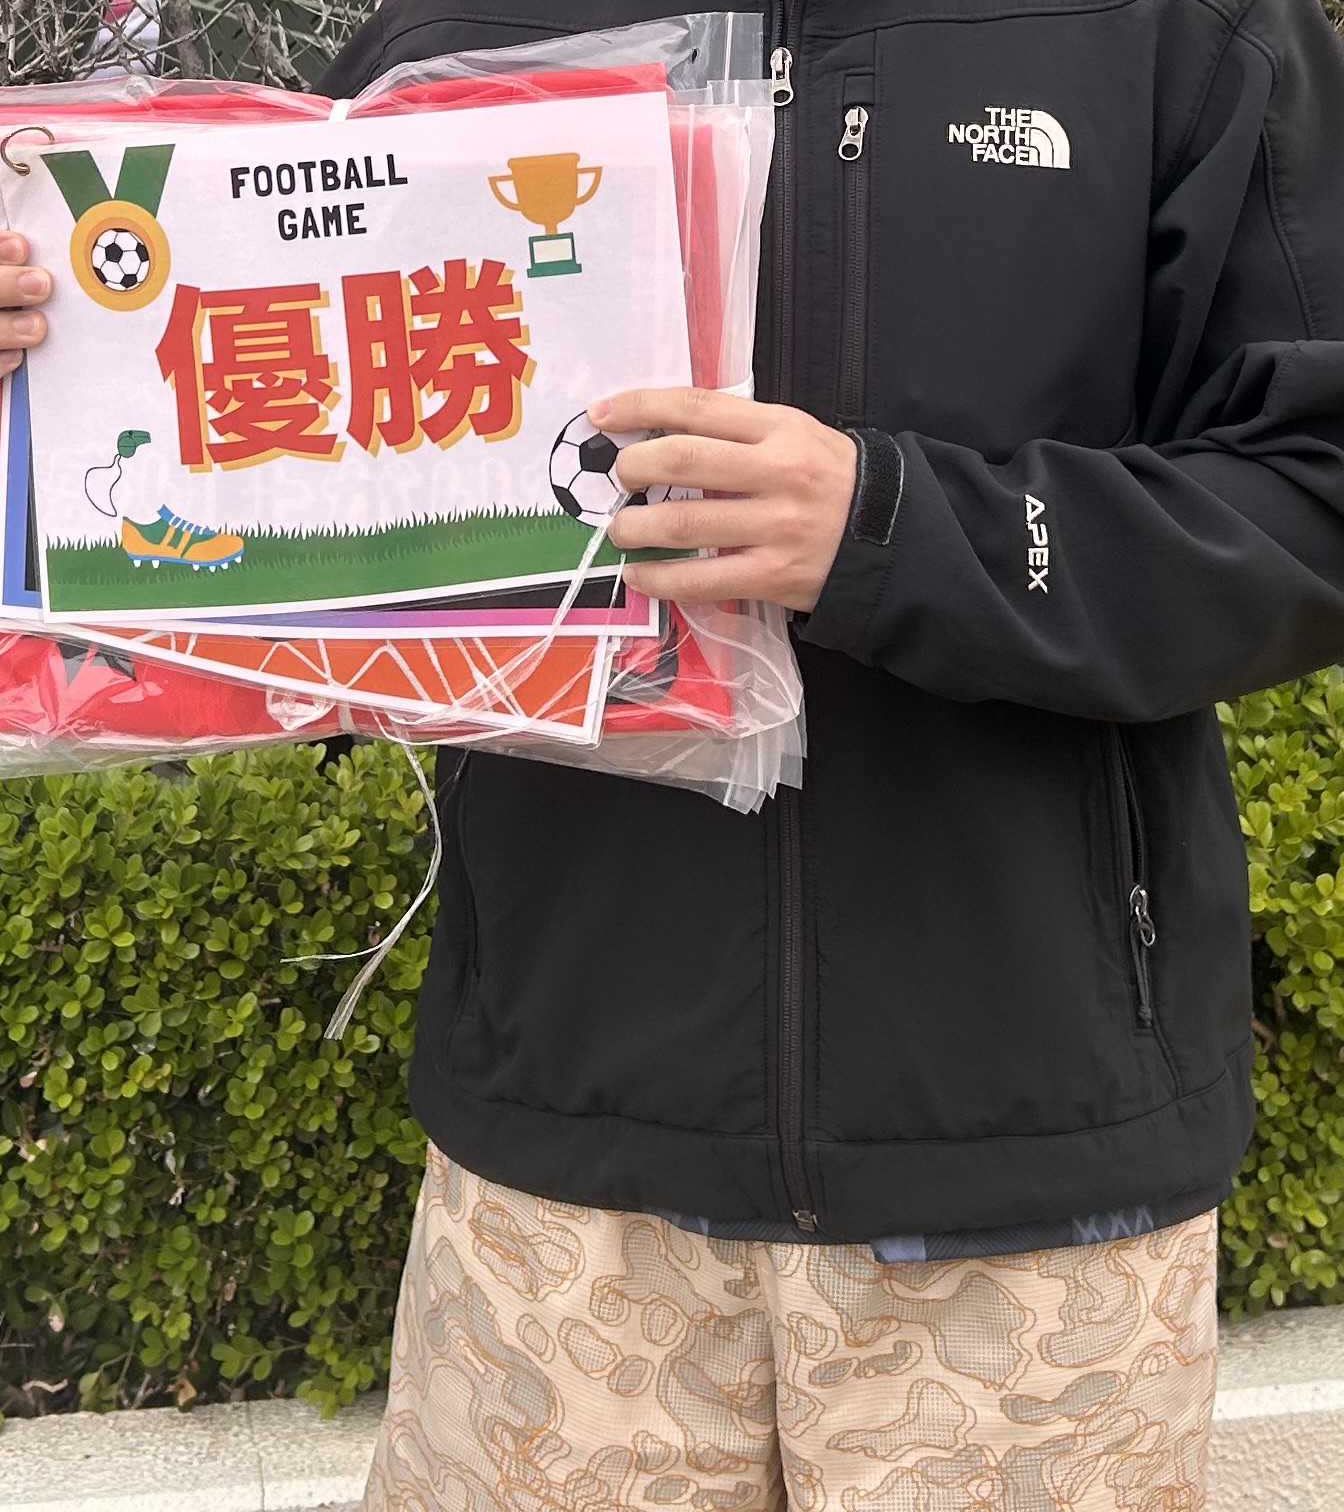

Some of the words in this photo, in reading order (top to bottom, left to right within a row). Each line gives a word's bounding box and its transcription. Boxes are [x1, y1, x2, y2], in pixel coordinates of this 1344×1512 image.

[948, 124, 1031, 146] NORTH
[984, 107, 1032, 127] THE
[972, 144, 1032, 165] FACE
[230, 154, 408, 199] FOOTBALL
[277, 203, 367, 241] GAME
[156, 258, 536, 473] 優勝
[1025, 493, 1049, 594] APEX
